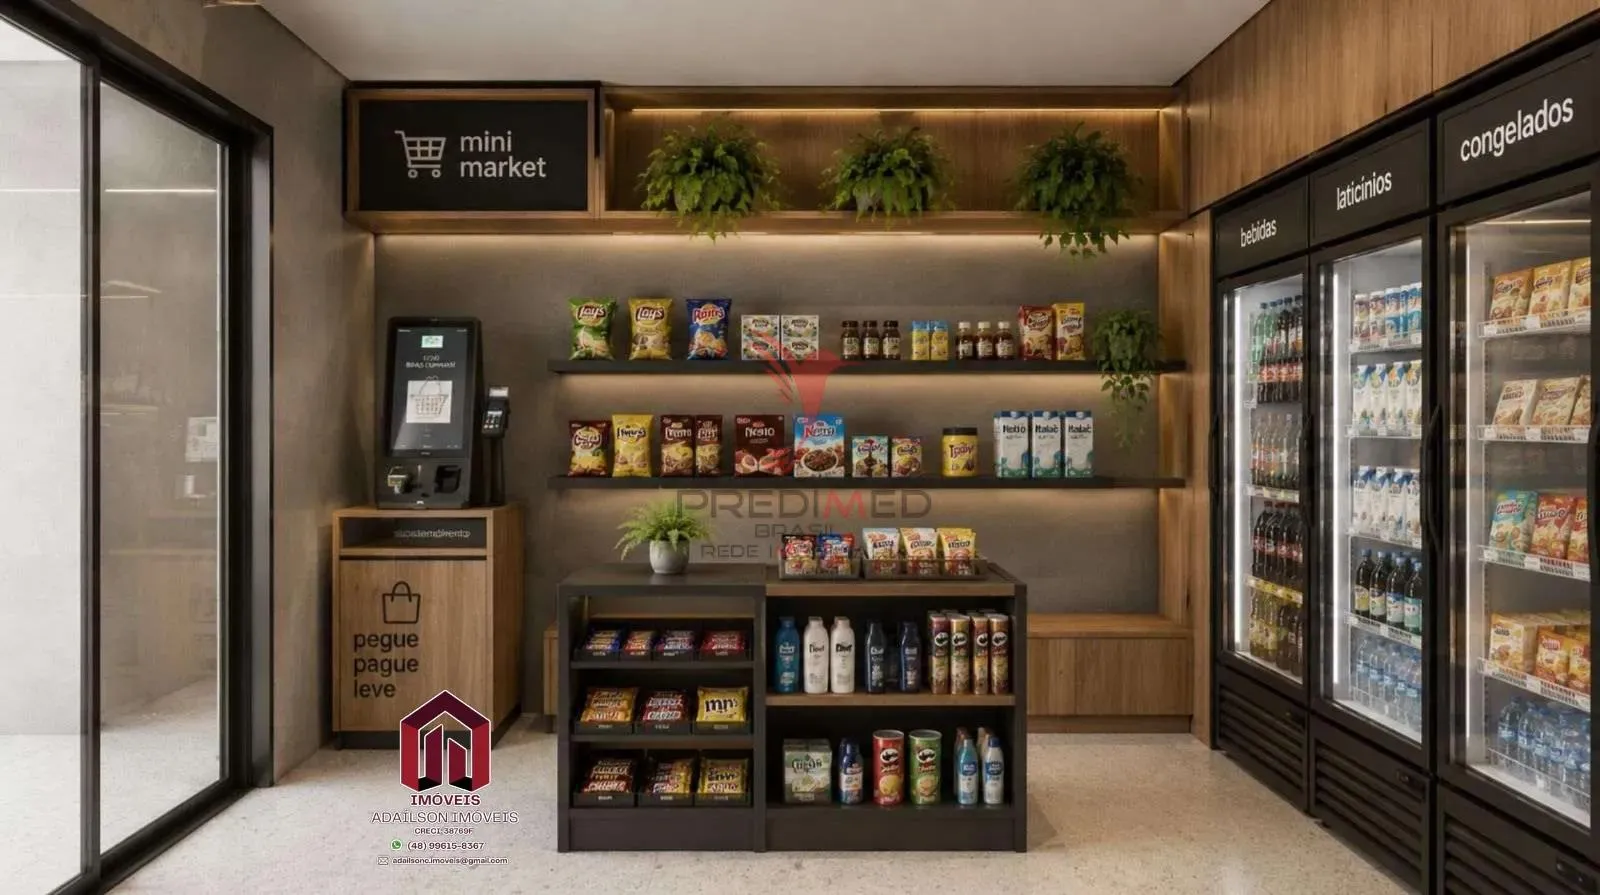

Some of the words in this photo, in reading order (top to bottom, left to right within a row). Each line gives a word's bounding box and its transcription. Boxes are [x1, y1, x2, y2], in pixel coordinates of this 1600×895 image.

[1460, 97, 1574, 162] congelados
[460, 130, 512, 153] mini
[460, 155, 547, 178] market
[1336, 170, 1392, 210] laticínios
[1240, 217, 1277, 248] bebidas
[353, 632, 419, 653] pegue
[353, 657, 419, 678] pague
[353, 679, 396, 698] leve
